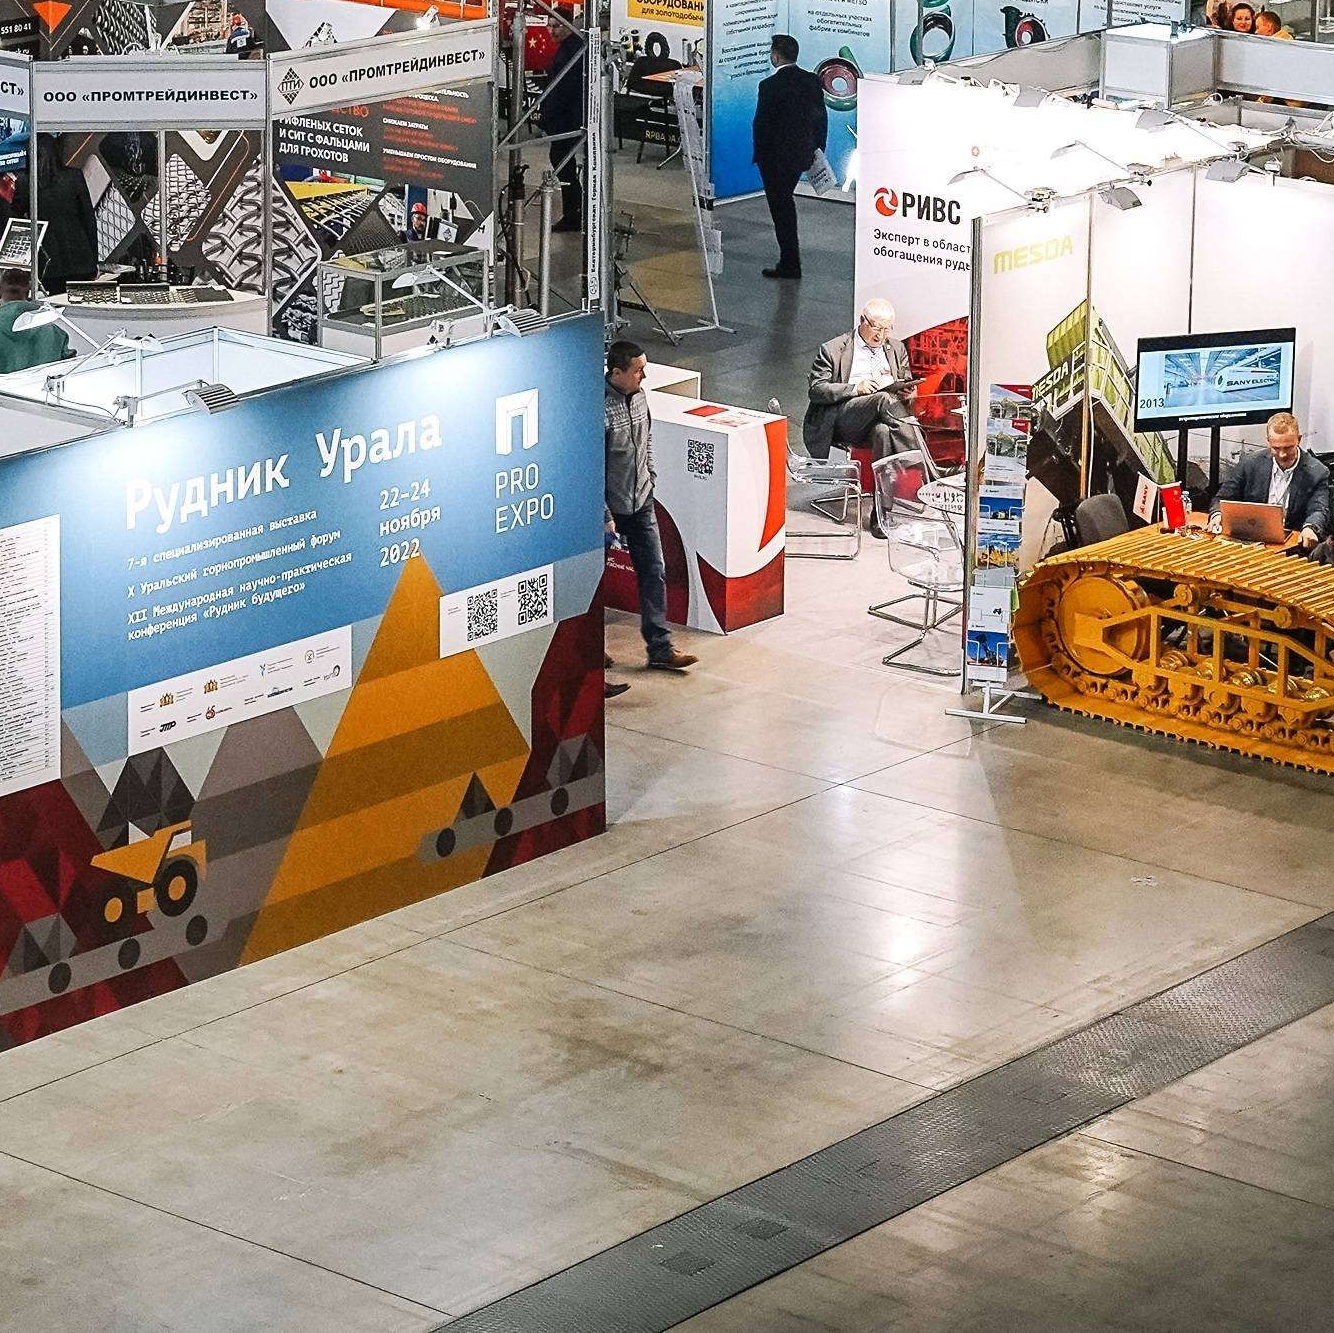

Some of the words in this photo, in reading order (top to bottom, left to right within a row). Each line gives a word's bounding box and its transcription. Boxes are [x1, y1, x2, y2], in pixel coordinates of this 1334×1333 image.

[309, 74, 337, 89] ООО
[342, 50, 485, 83] «ПРОМТРЕЙДИНВЕСТ»
[43, 91, 77, 103] ООО
[82, 88, 258, 105] «ПРОМТРЕЙДИНВЕСТ»
[281, 80, 300, 92] ПТИ
[279, 117, 331, 132] РИФЛЕНЫХ
[333, 123, 363, 136] СЕТОК
[287, 130, 305, 141] СИТ
[315, 134, 370, 153] ФАЛЬЦАМИ
[279, 142, 299, 155] ДЛЯ
[301, 145, 349, 163] ГРОХОТОВ
[903, 193, 961, 225] РИВС
[874, 229, 920, 246] Эксперт
[932, 240, 971, 253] област
[874, 246, 942, 265] обогащения
[994, 235, 1073, 274] MESDA
[1140, 398, 1165, 409] 2013
[125, 454, 290, 535] Рудник
[316, 414, 443, 484] Урала
[494, 463, 540, 499] PRO
[379, 479, 431, 511] 22-24
[379, 505, 442, 537] ноября
[494, 494, 554, 534] EXPO
[128, 556, 147, 570] 7-я
[154, 524, 263, 563] специализированная
[270, 509, 316, 531] выставка
[379, 538, 420, 568] 2022
[140, 569, 197, 596] Уральский
[203, 539, 305, 577] горнопромышленный
[311, 530, 341, 549] форум
[153, 586, 234, 617] Международная
[239, 552, 352, 592] научно-практическая
[128, 612, 197, 641] конференция
[203, 600, 246, 619] «Рудник
[251, 583, 305, 606] будущего»
